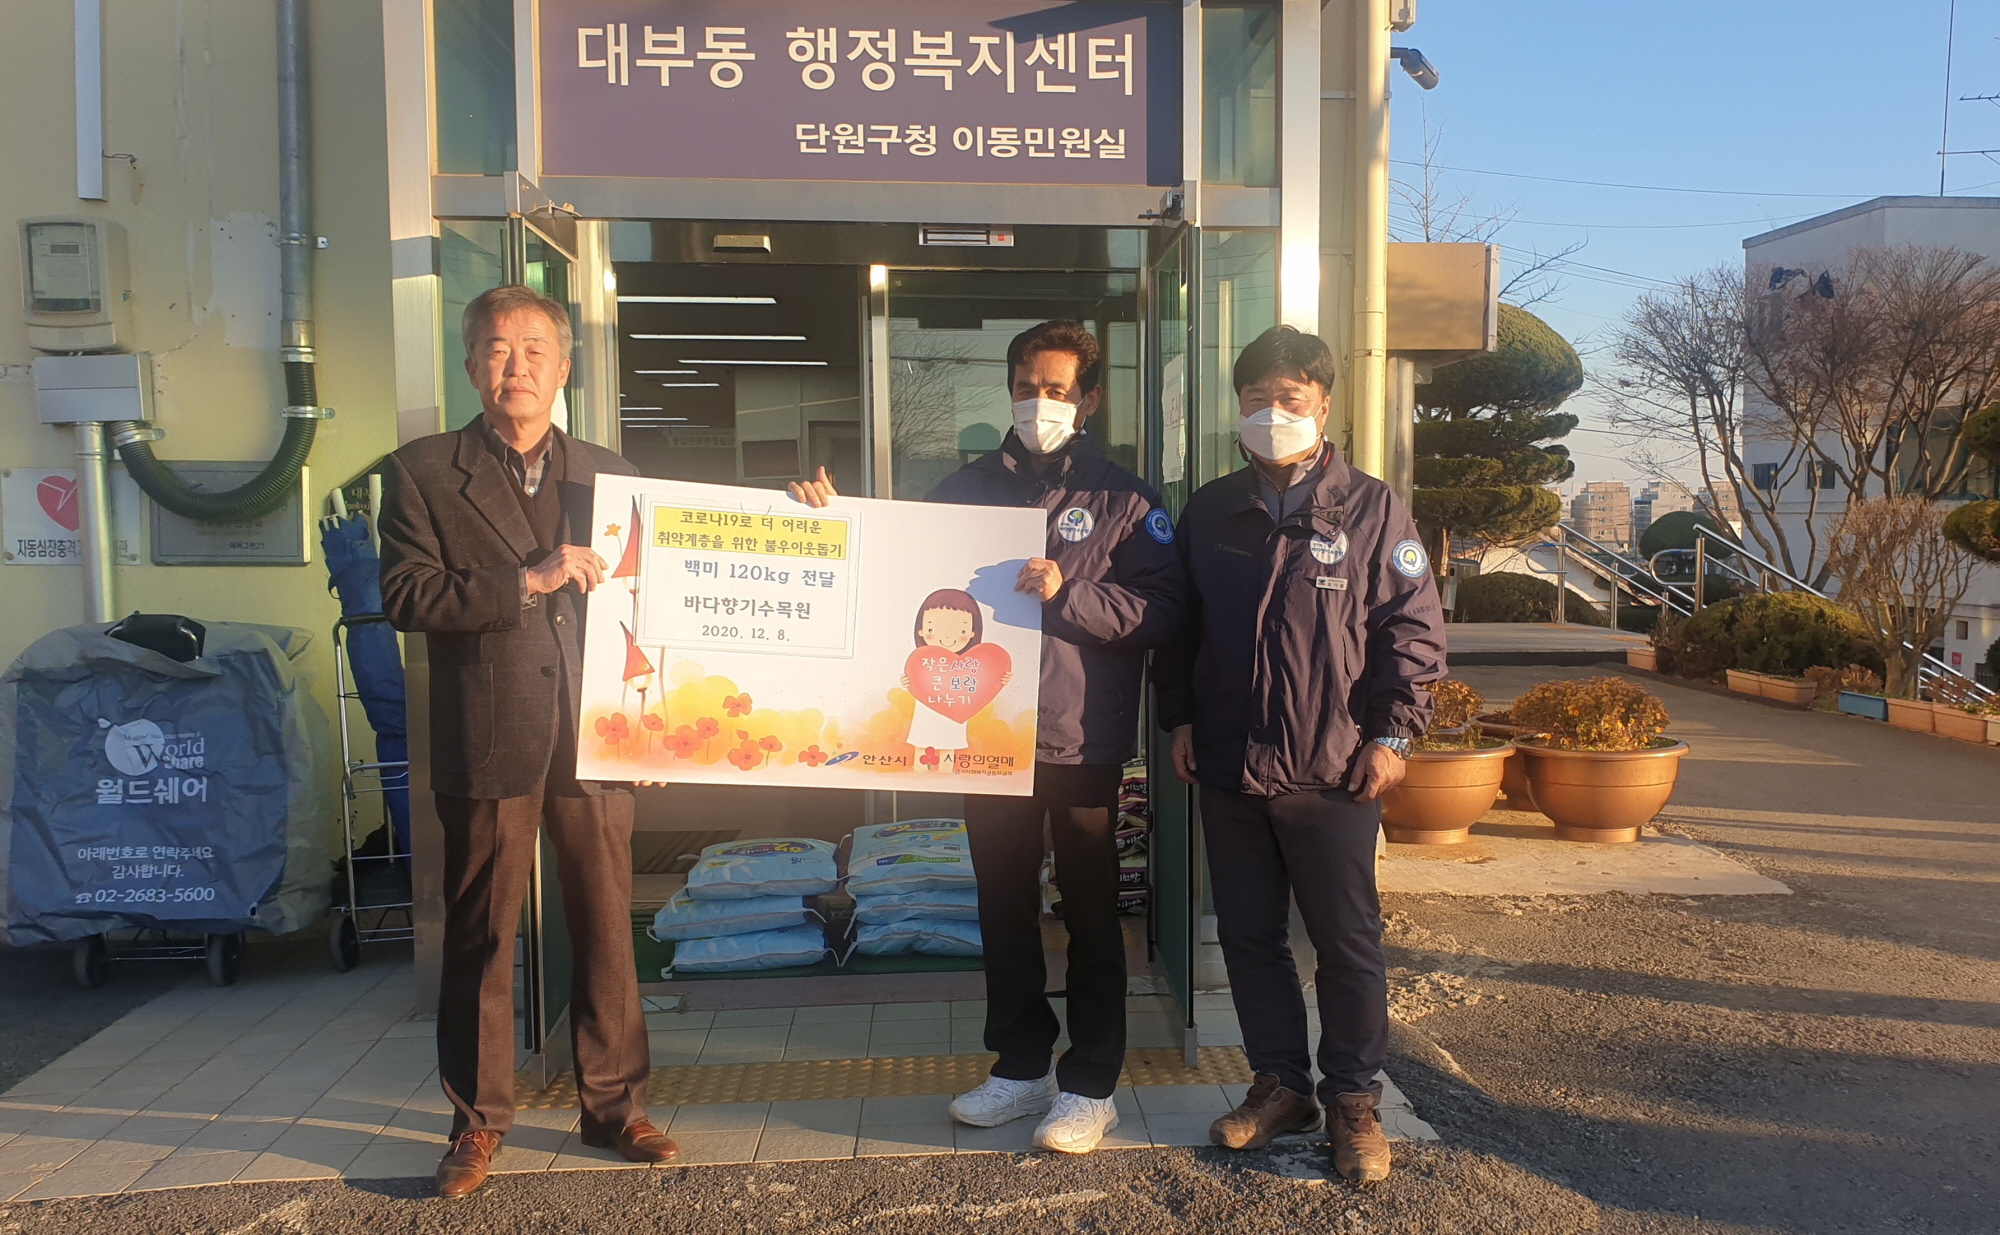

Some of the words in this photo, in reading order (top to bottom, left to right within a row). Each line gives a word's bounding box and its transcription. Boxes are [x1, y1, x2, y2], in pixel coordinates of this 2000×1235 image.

[578, 23, 756, 89] 대부동
[786, 26, 1133, 96] 행정복지센터
[796, 123, 937, 156] 단원구청
[952, 126, 1126, 159] 이동민원실
[680, 510, 753, 528] 코로나19로
[761, 516, 774, 531] 더
[781, 518, 822, 535] 어려운
[657, 531, 725, 549] 취약계층을
[731, 536, 758, 551] 위한
[764, 539, 842, 558] 불우이웃돕기
[684, 559, 719, 579] 백미
[729, 563, 790, 585] 120kg
[801, 569, 836, 589] 전달
[684, 595, 811, 620] 바다향기수목원
[701, 624, 743, 640] 2020.
[751, 627, 769, 641] 12.
[777, 629, 790, 642] 8.
[921, 657, 949, 673] 작은
[950, 656, 981, 675] 사랑
[931, 675, 944, 691] 큰
[949, 675, 979, 693] 보람
[928, 693, 971, 708] 나누기
[126, 737, 206, 769] World
[862, 754, 907, 767] 안산시
[943, 753, 1014, 770] 사랑의열매
[162, 755, 205, 770] Share
[95, 775, 208, 805] 월드쉐어
[77, 846, 149, 861] 아래번호로
[152, 845, 215, 860] 연락주세요
[112, 864, 184, 879] 감사합니다.
[95, 886, 215, 903] 02-2683-5600
